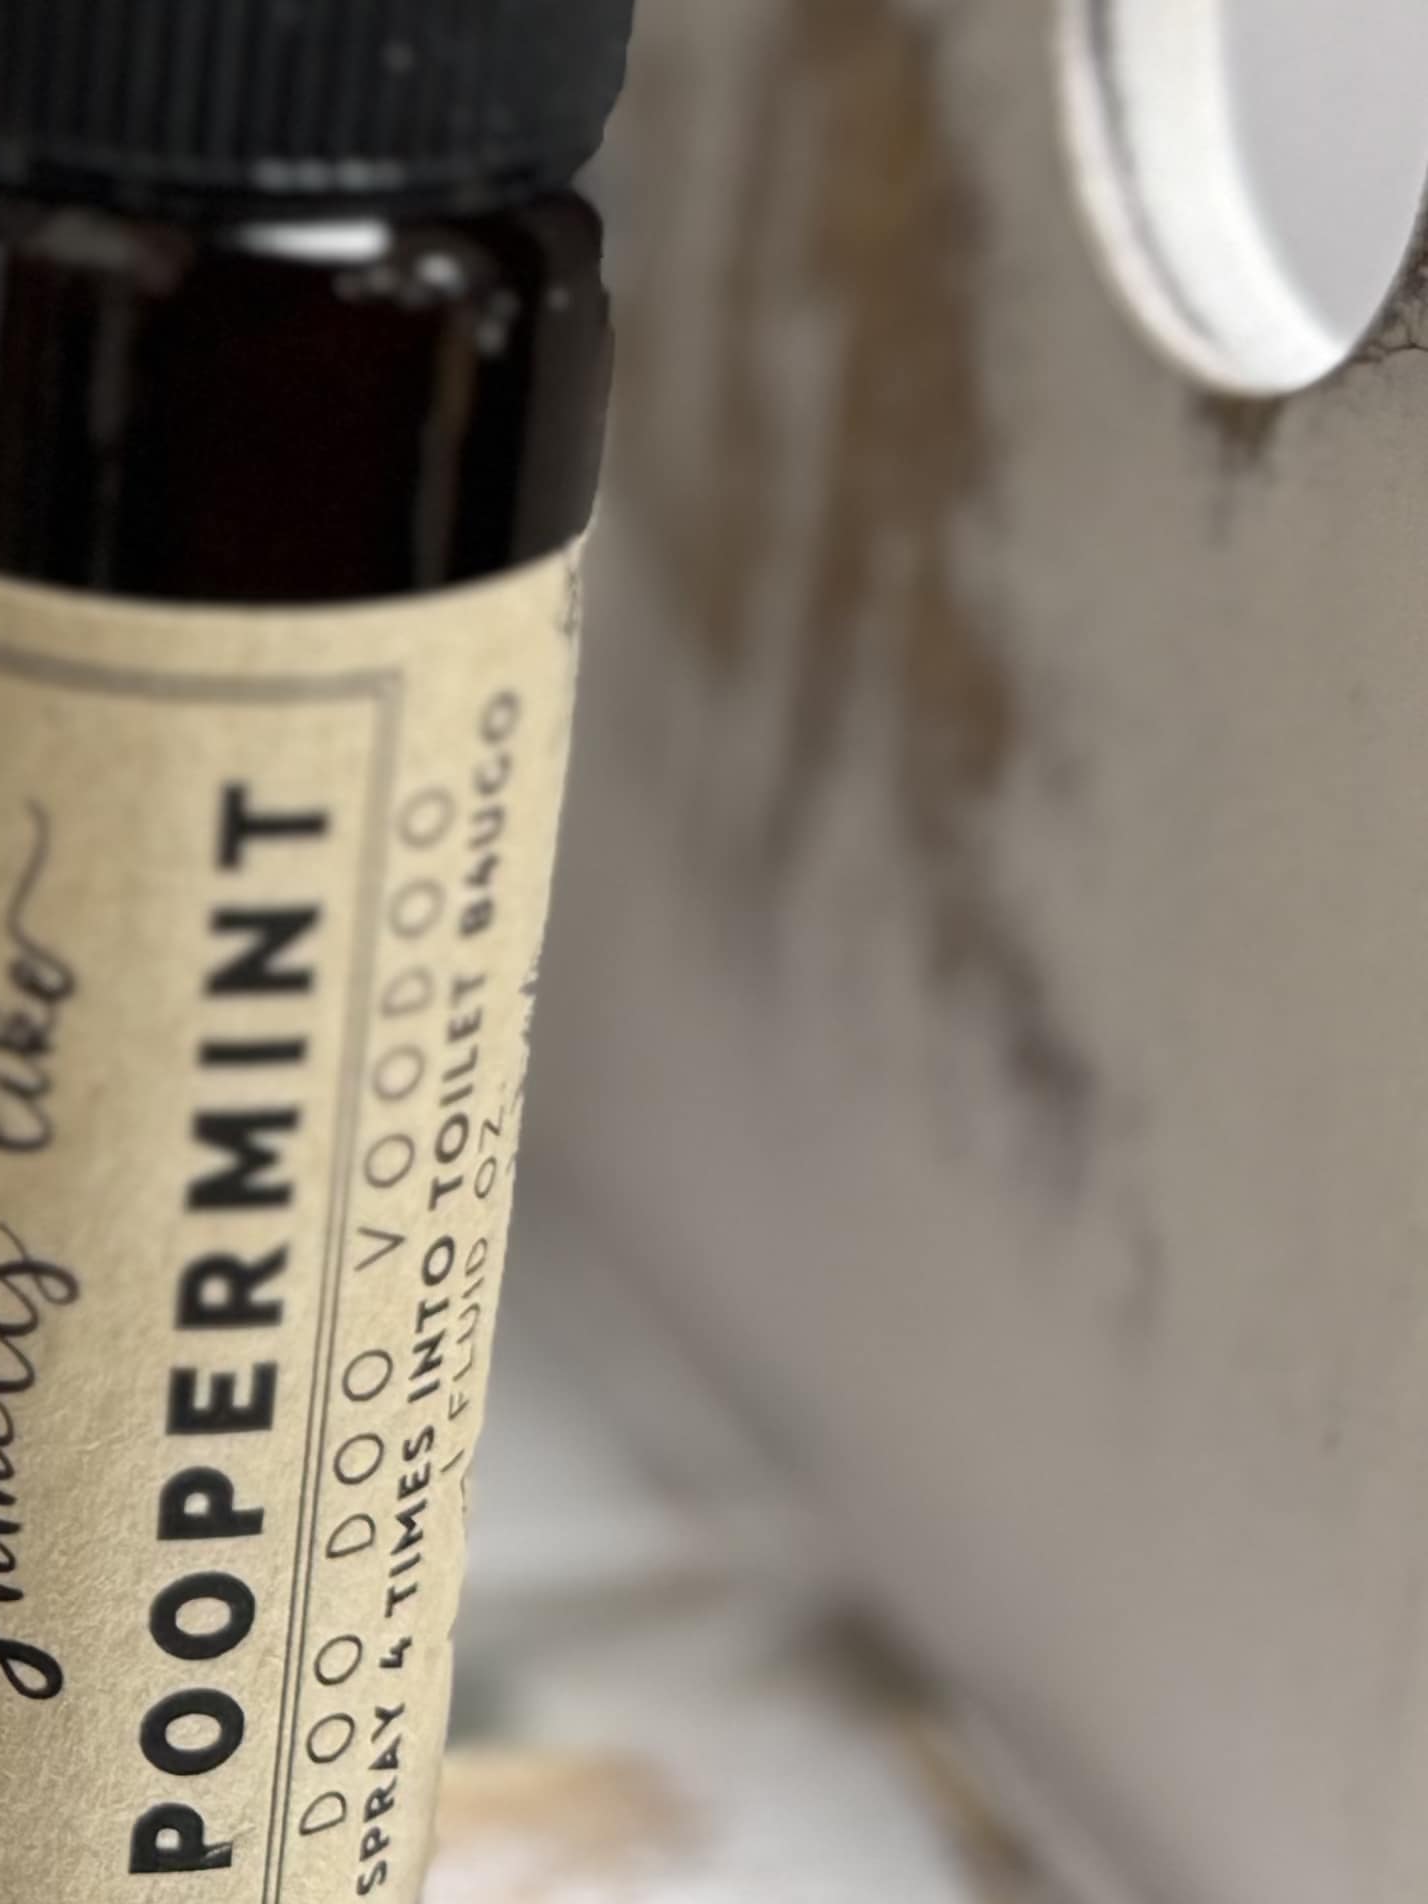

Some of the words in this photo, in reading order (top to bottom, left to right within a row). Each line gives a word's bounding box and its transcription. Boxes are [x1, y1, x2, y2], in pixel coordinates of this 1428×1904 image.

[352, 783, 457, 1272] VOODOO
[427, 968, 486, 1211] TOILET
[126, 779, 332, 1875] POOPERMINT
[406, 1234, 456, 1403] INTO
[447, 1235, 489, 1421] FLUID
[324, 1346, 395, 1558] DOO
[383, 1423, 436, 1618] TIMES
[297, 1632, 364, 1836] DOO
[378, 1634, 413, 1670] 4
[355, 1700, 406, 1897] SPRAY
